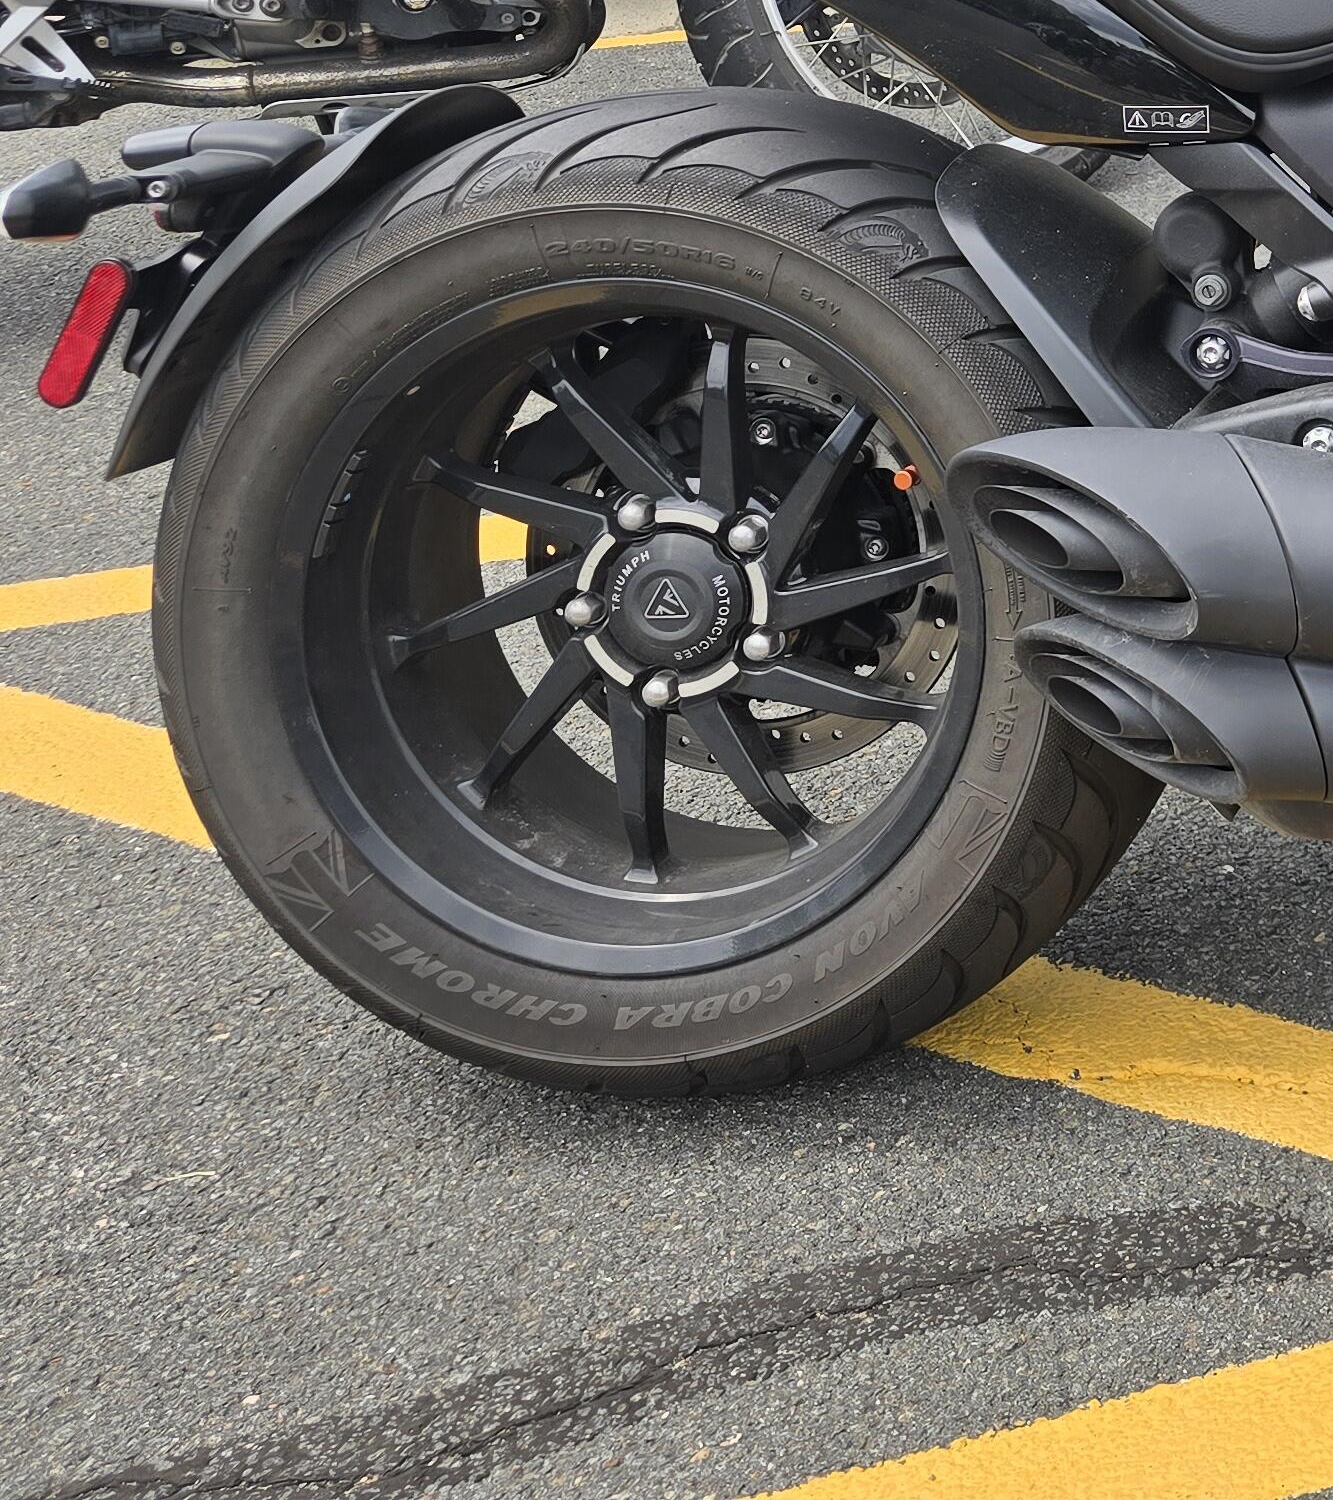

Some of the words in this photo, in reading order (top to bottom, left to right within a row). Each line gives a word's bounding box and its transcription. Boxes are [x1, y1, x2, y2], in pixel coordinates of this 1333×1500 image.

[543, 238, 736, 270] 240/50R16
[611, 550, 650, 612] TRIUMPH
[674, 574, 731, 661] MOTORCYCLES
[813, 866, 948, 984] AVON
[355, 922, 589, 1027] CHROME
[613, 973, 796, 1031] COBRA
